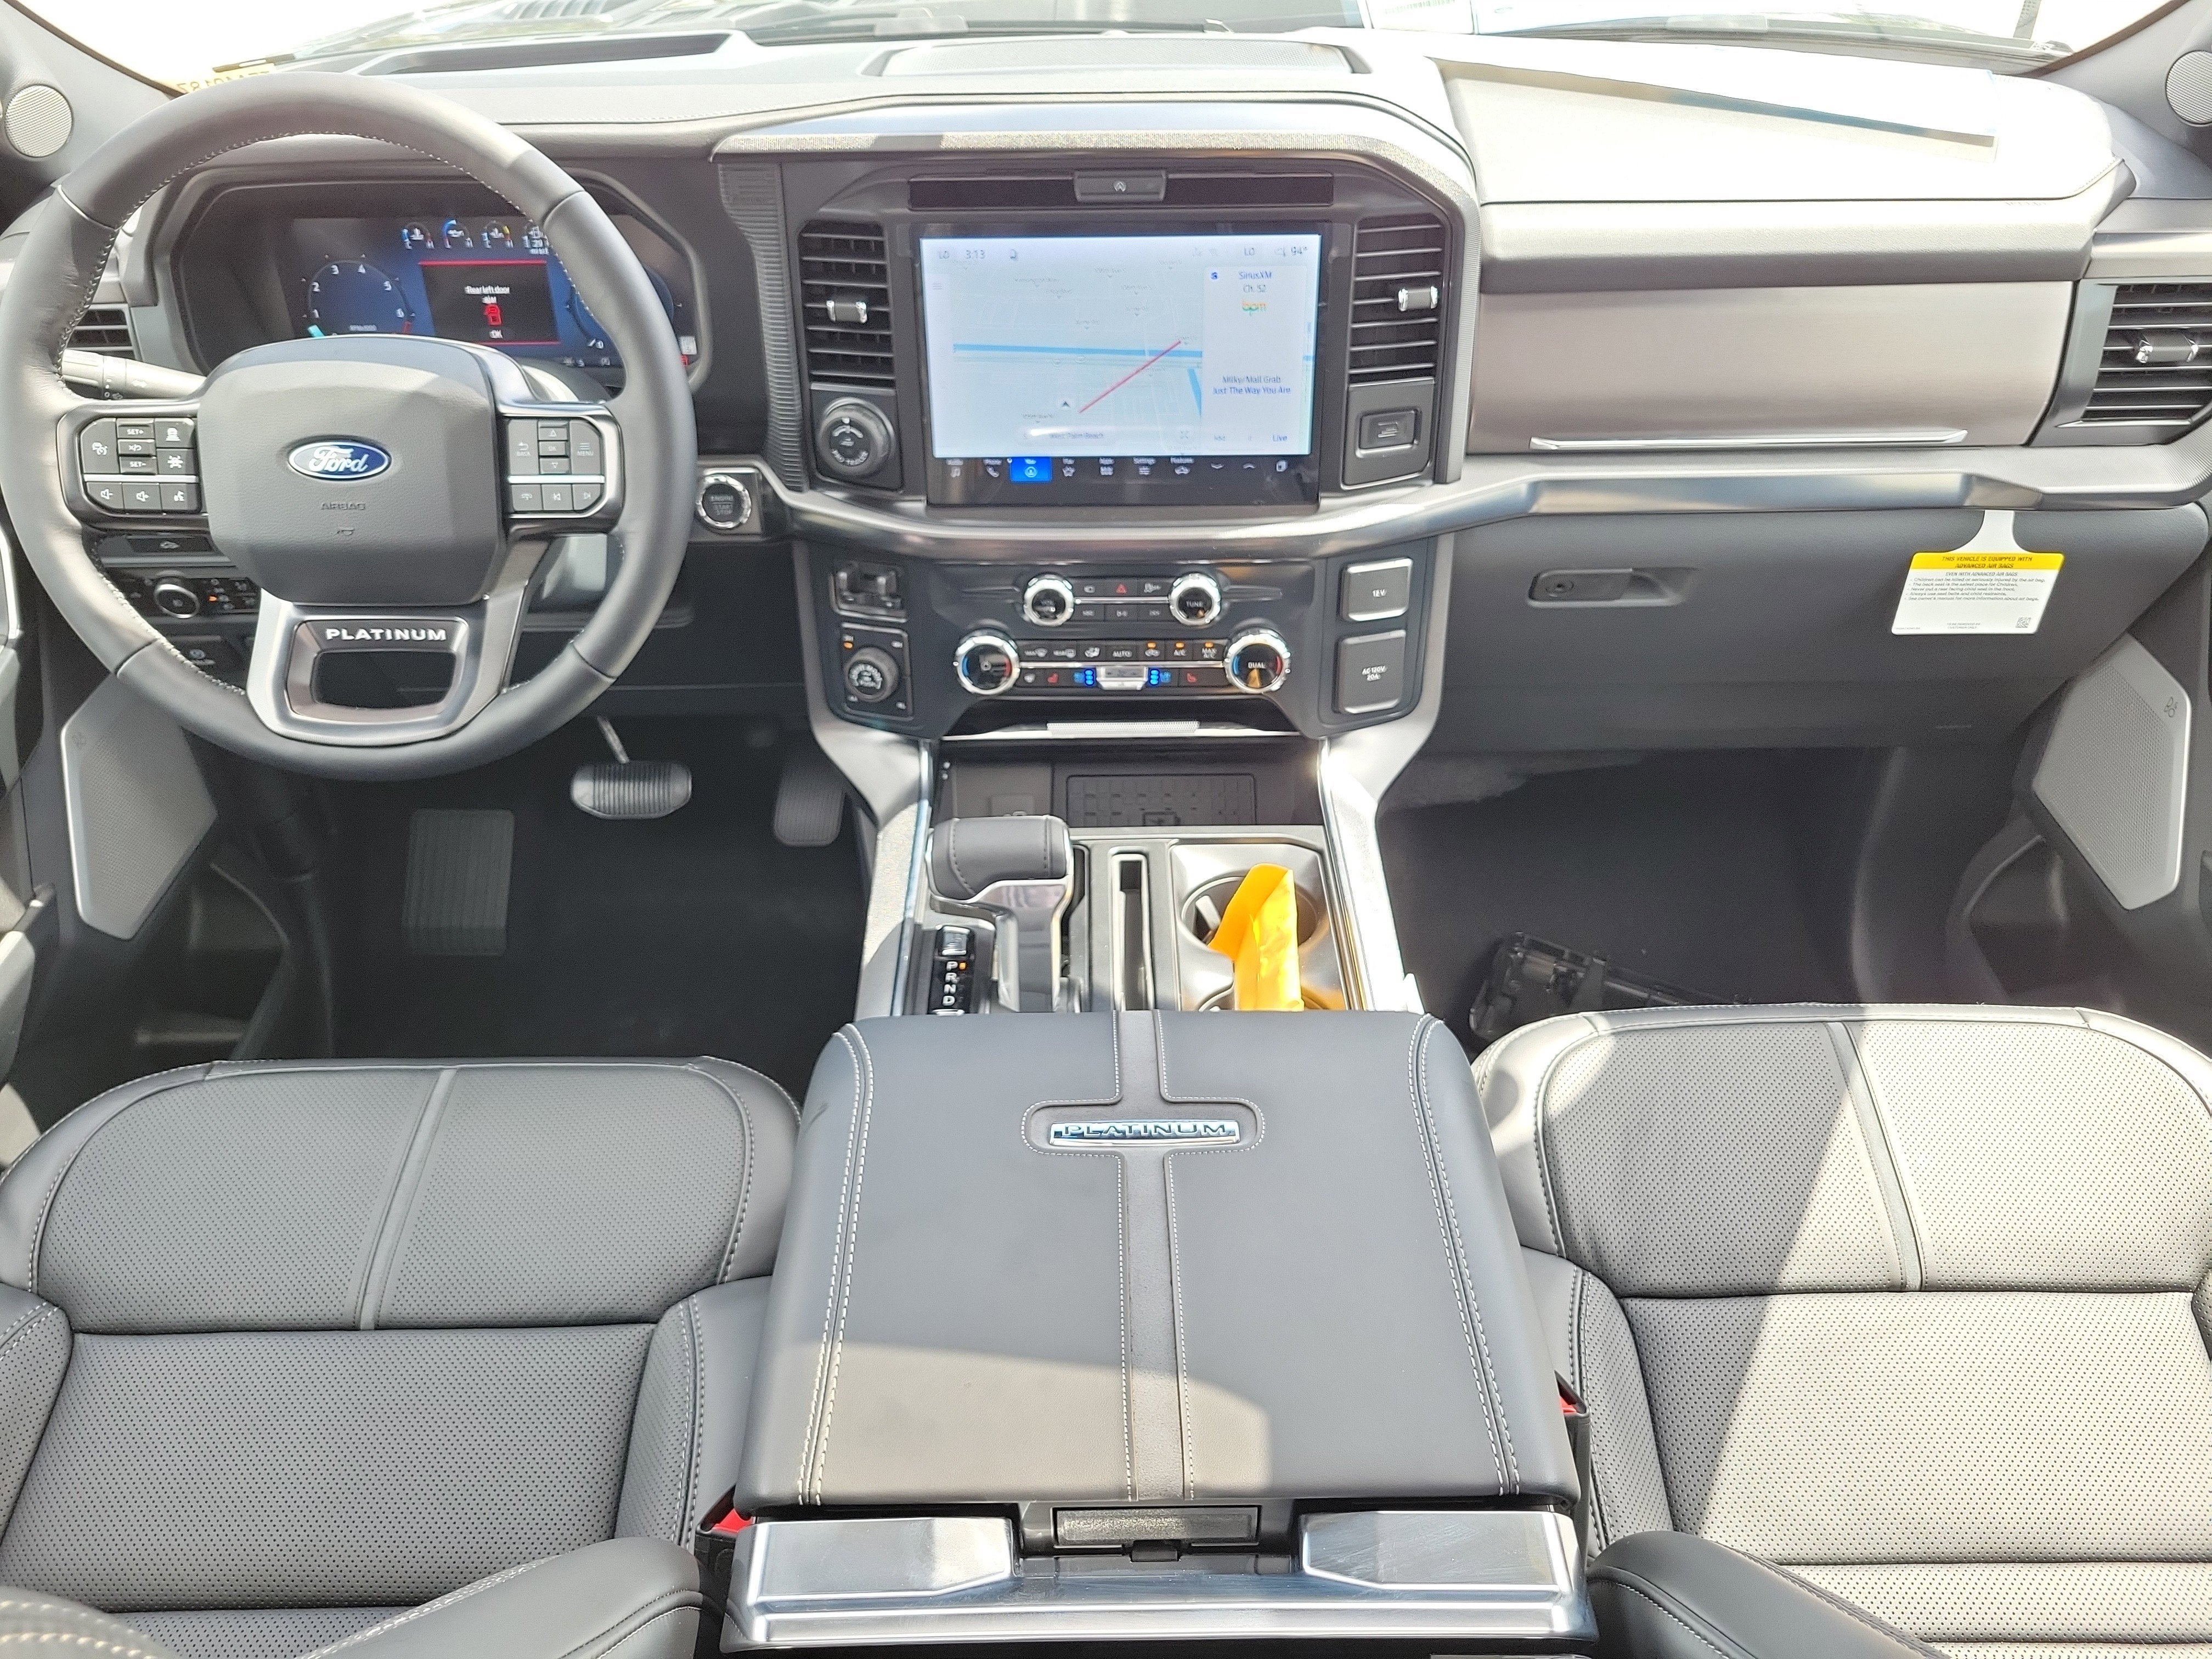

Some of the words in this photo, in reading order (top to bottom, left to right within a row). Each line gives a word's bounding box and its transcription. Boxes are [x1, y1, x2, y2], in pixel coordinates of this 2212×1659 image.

[331, 264, 339, 275] 3
[357, 264, 366, 274] 4
[1239, 270, 1272, 279] SiriusXM
[312, 282, 320, 292] 2
[383, 281, 392, 291] 5
[313, 309, 319, 318] 1
[1244, 387, 1261, 396] Way
[308, 445, 369, 473] Ford
[1373, 589, 1387, 597] 12V
[325, 628, 447, 641] PLATINUM
[946, 961, 958, 971] P
[945, 972, 959, 984] R
[944, 984, 956, 994] N
[942, 995, 955, 1007] D
[1063, 1122, 1231, 1138] PLATINUM
